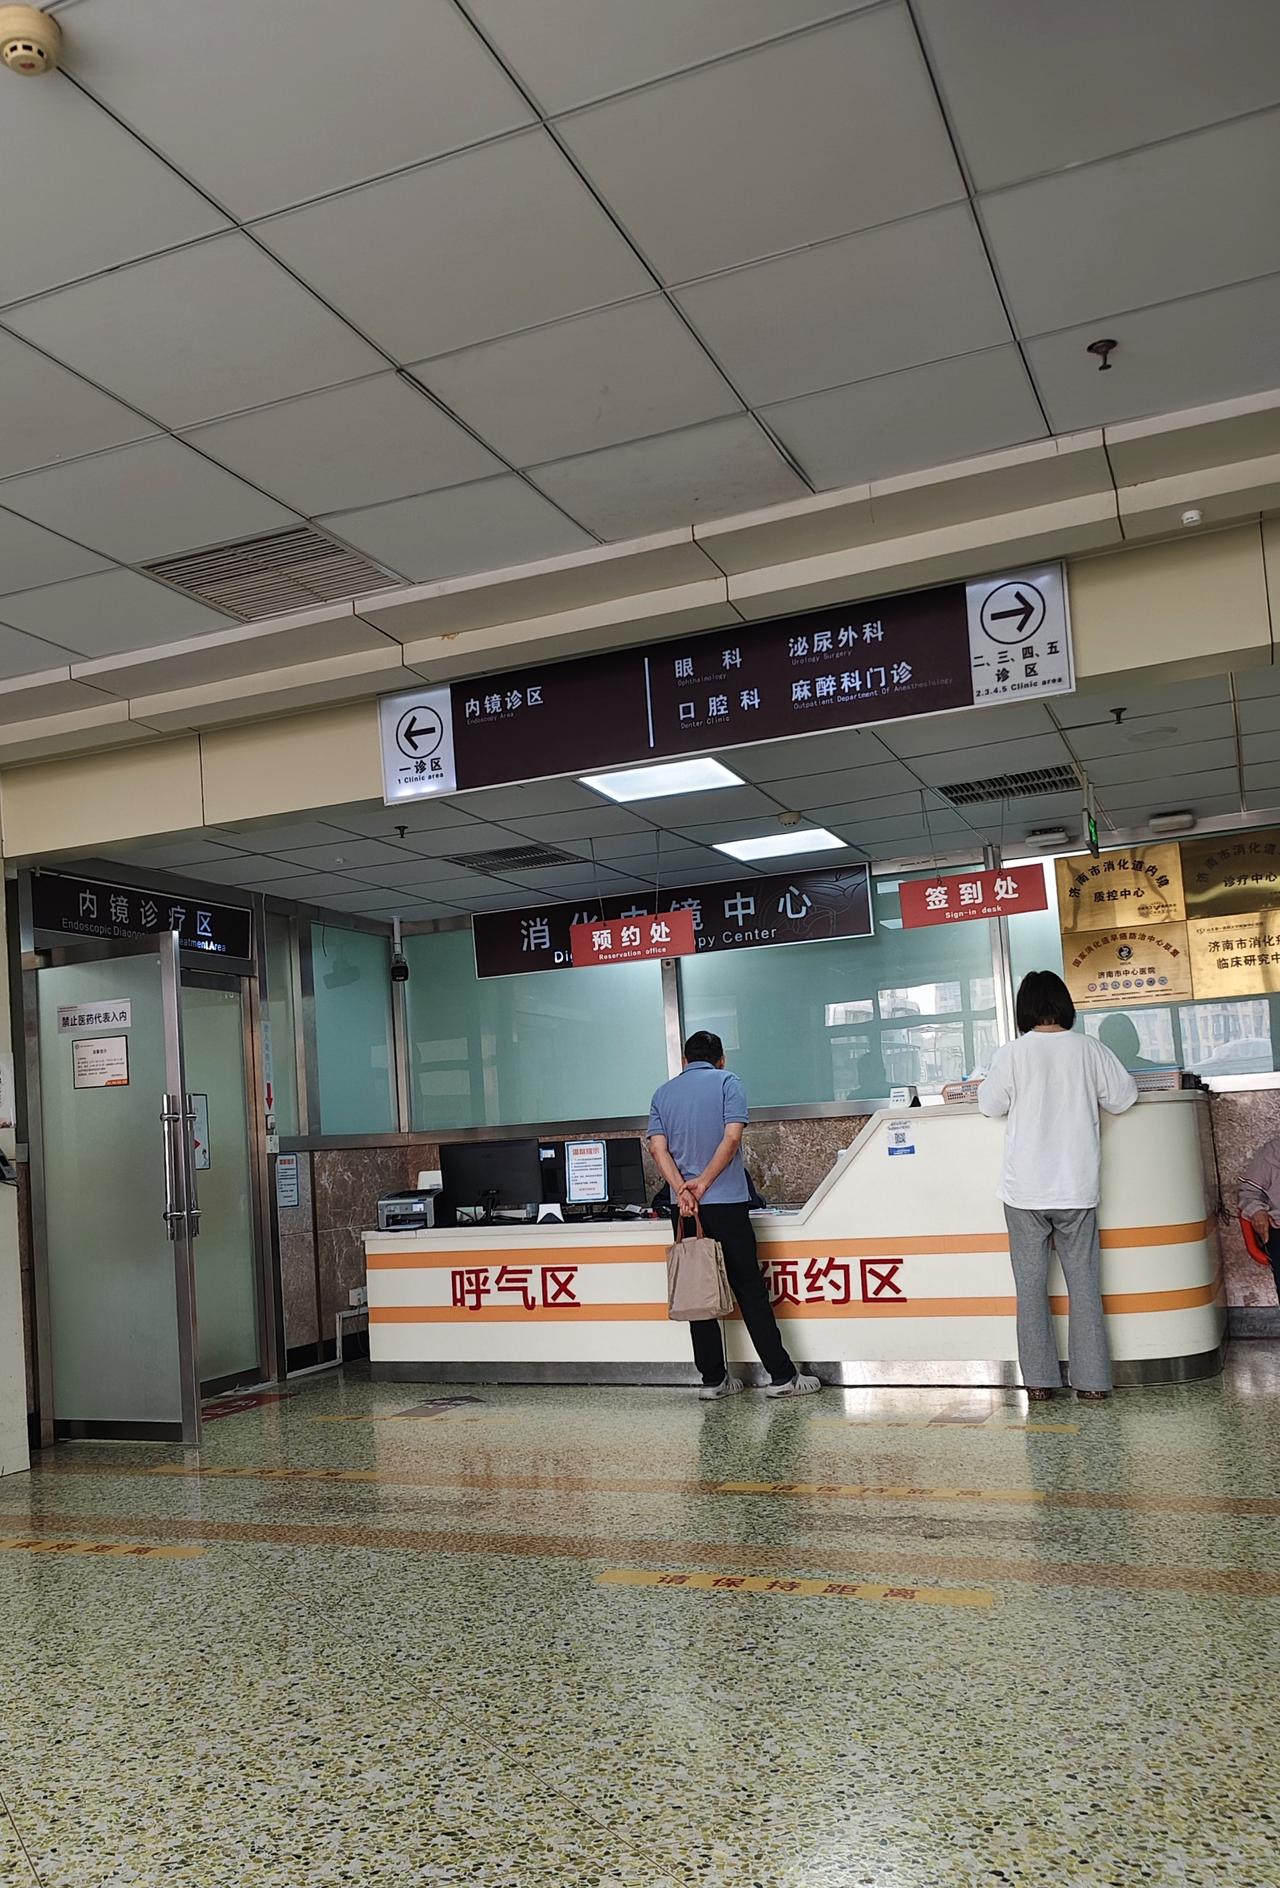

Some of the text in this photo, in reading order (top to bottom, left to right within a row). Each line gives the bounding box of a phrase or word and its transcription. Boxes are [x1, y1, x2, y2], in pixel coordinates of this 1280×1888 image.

[787, 620, 885, 659] 泌尿外科
[791, 650, 853, 666] Urology Surgery
[972, 640, 1060, 668] 二、三、四、五
[790, 661, 913, 703] 麻醉科门诊
[995, 662, 1039, 683] 诊区
[1010, 681, 1038, 691] Clinic
[1041, 676, 1063, 686] area
[464, 685, 544, 719] 内镜诊区
[678, 687, 761, 721] 口腔科
[793, 698, 834, 710] Outpatient
[837, 689, 879, 703] Department
[881, 687, 891, 695] Of
[706, 716, 731, 726] Clinic
[398, 757, 443, 774] 一诊区
[404, 774, 426, 784] Clinic
[427, 772, 444, 780] area
[1223, 871, 1278, 887] 诊疗中心
[924, 876, 1019, 910] 签到处
[1093, 887, 1145, 903] 质控中心
[78, 889, 213, 937] 内镜诊疗区
[945, 906, 1003, 920] Sign-in desk
[61, 917, 113, 935] Endoscopic
[208, 941, 227, 952] Area
[591, 921, 671, 952] 预约处
[721, 927, 778, 945] Center
[598, 947, 667, 961] Reservation office
[61, 1009, 128, 1028] 禁止医药代表入内
[450, 1265, 582, 1311] 呼气区
[656, 1573, 921, 1600] 请保持距离
